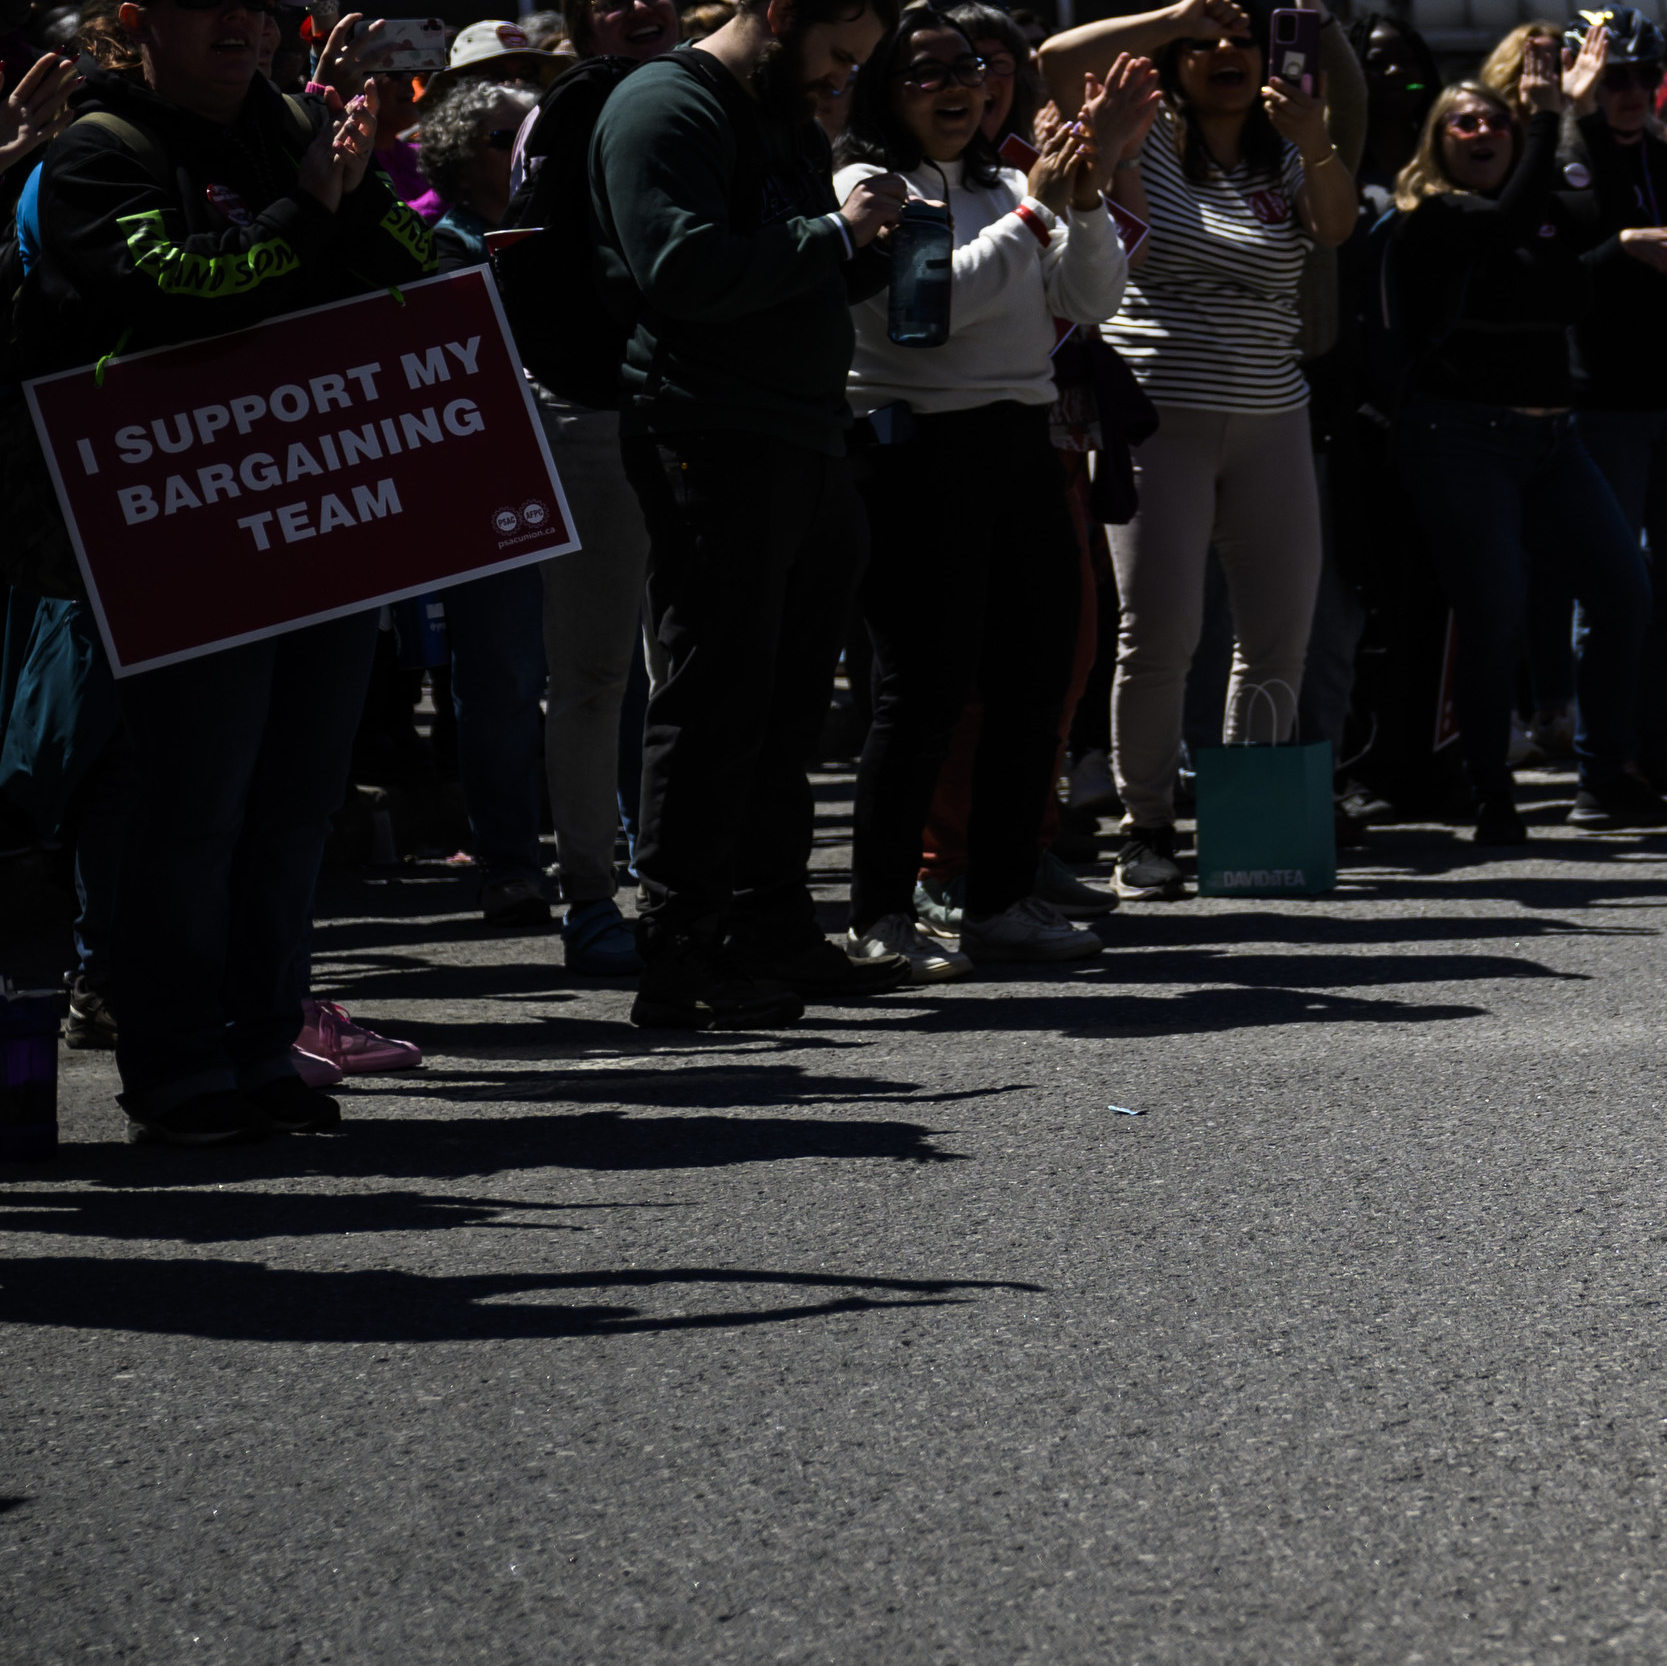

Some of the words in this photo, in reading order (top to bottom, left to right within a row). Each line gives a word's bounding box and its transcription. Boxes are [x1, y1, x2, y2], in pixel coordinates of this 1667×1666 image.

[76, 438, 99, 476] I
[114, 362, 382, 465] SUPPORT
[399, 335, 482, 390] MY
[116, 397, 486, 526] BARGAINING
[237, 478, 403, 552] TEAM
[497, 516, 516, 527] PSAC
[526, 508, 543, 519] AFPC
[497, 527, 556, 550] psacunion.ca
